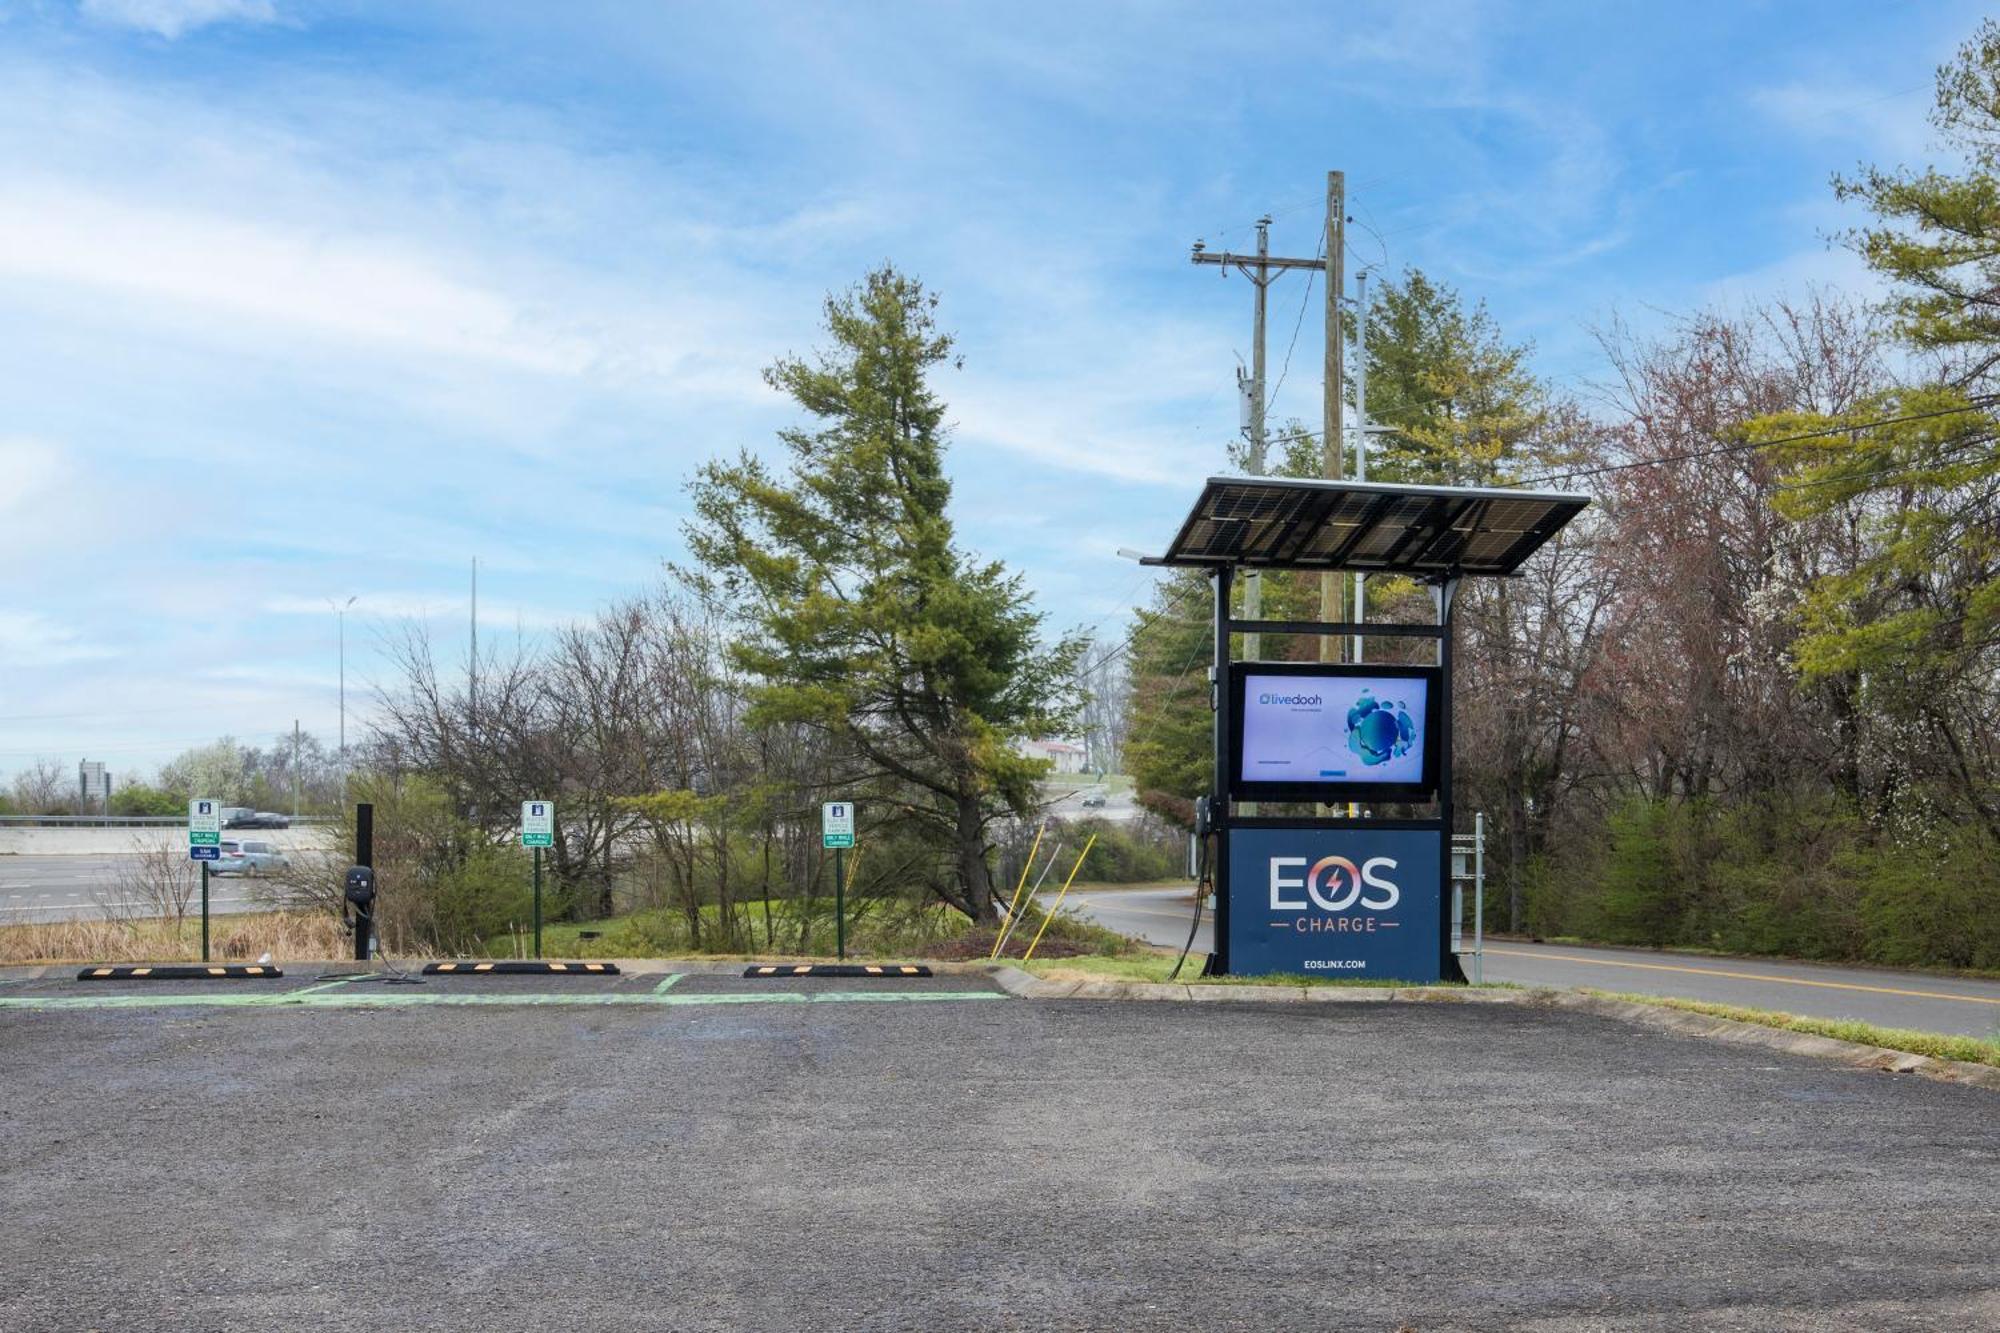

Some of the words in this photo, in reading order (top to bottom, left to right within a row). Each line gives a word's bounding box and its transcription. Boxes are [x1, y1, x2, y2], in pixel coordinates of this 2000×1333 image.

[1271, 693, 1322, 705] livedooh
[1270, 855, 1400, 912] EOS
[1296, 917, 1377, 933] CHARGE
[1304, 960, 1366, 969] EOSLINX.COM
